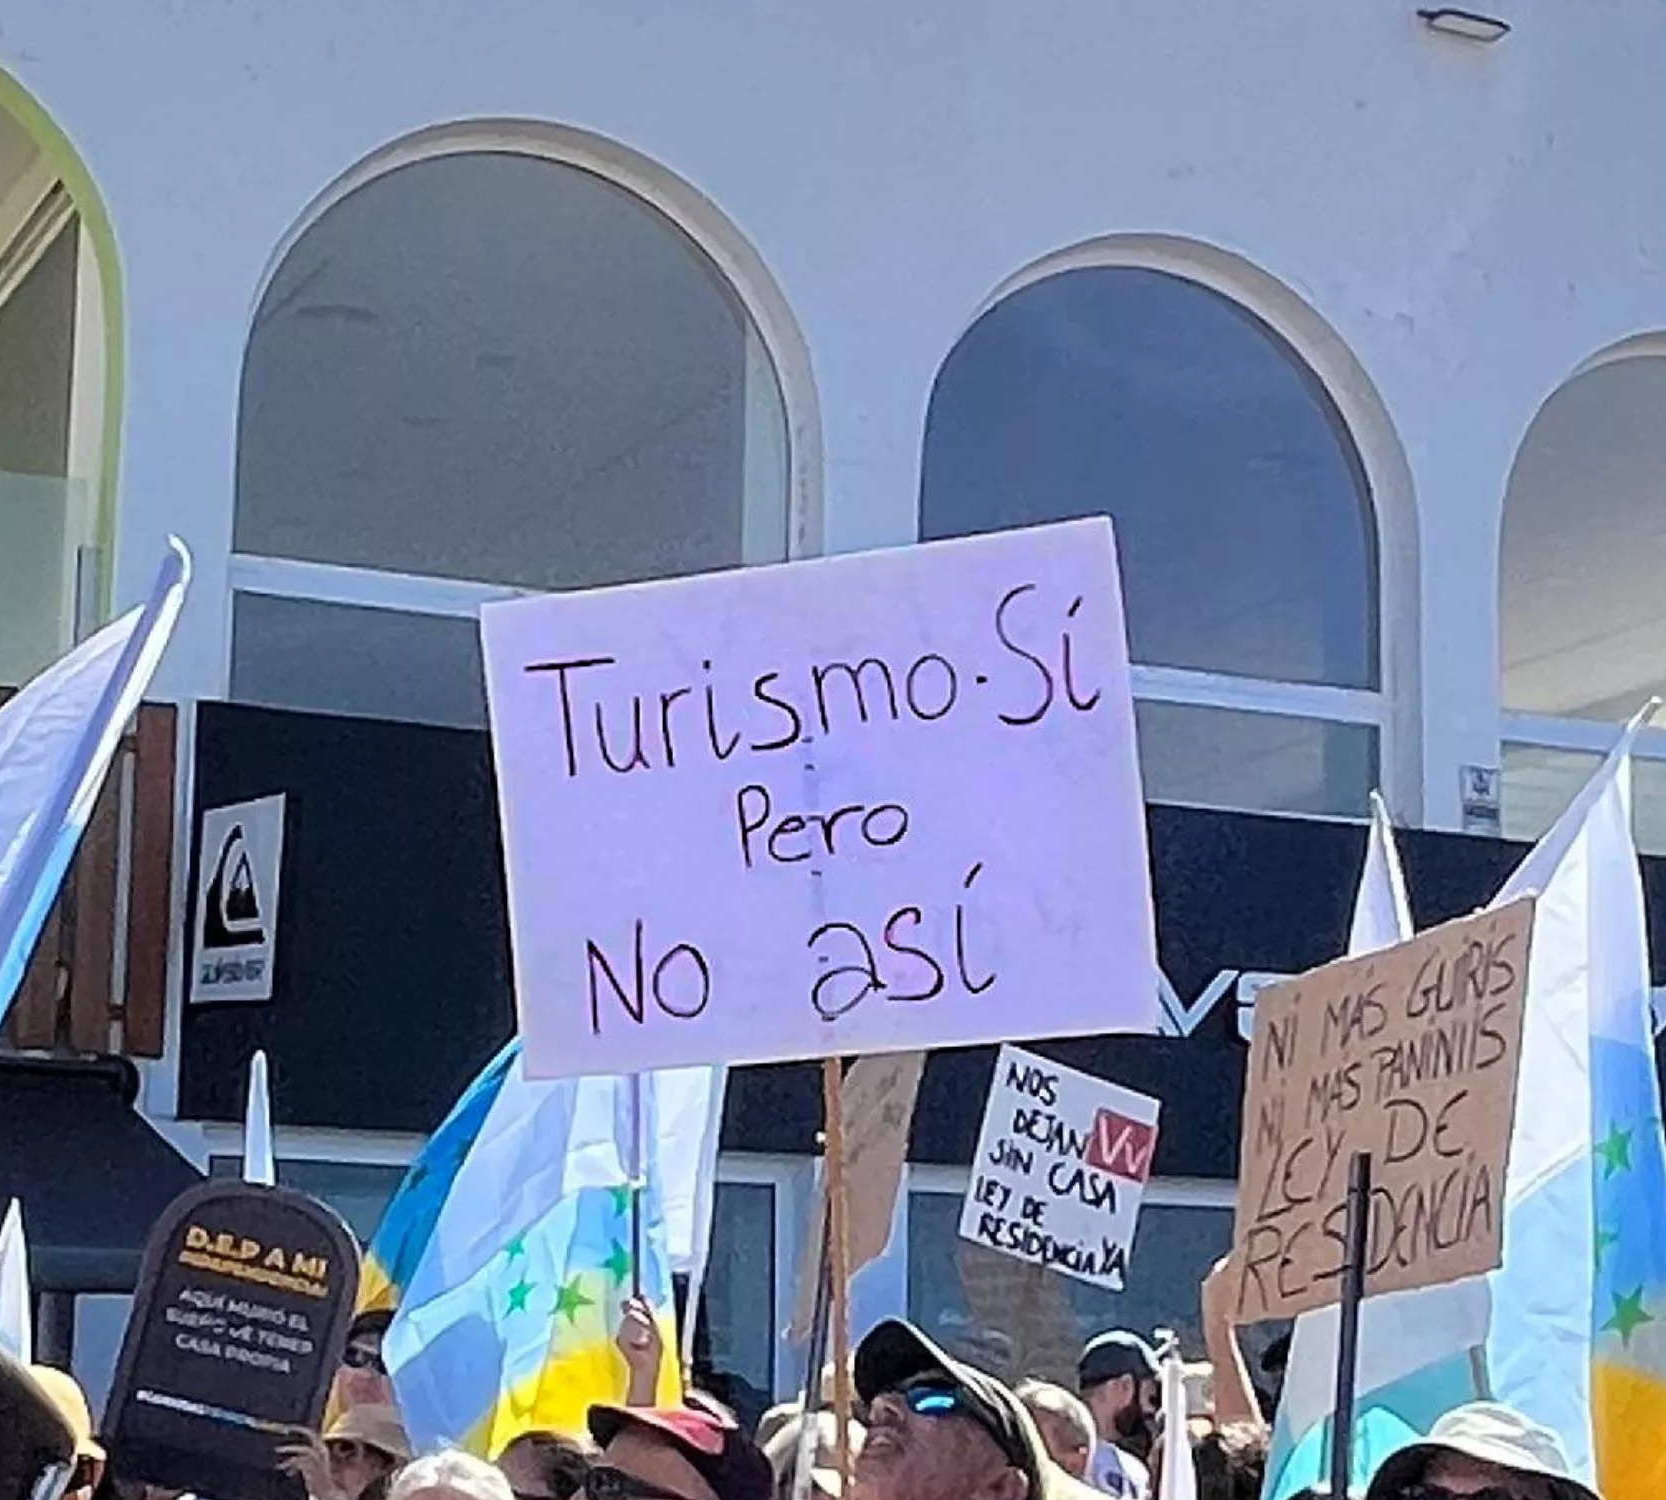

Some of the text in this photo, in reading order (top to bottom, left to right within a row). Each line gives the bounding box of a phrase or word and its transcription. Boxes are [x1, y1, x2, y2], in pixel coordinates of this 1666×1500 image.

[736, 784, 909, 868] Pero
[808, 861, 996, 1021] así
[1005, 1061, 1060, 1107] NOS
[1012, 1107, 1089, 1160] DEJAN
[1256, 1089, 1470, 1222] LEY DE
[974, 1175, 1048, 1228] LEY DE
[1048, 1161, 1117, 1215] CASA
[1237, 1146, 1493, 1315] RESDENCIA
[263, 1247, 286, 1271] A
[1096, 1235, 1126, 1280] YA
